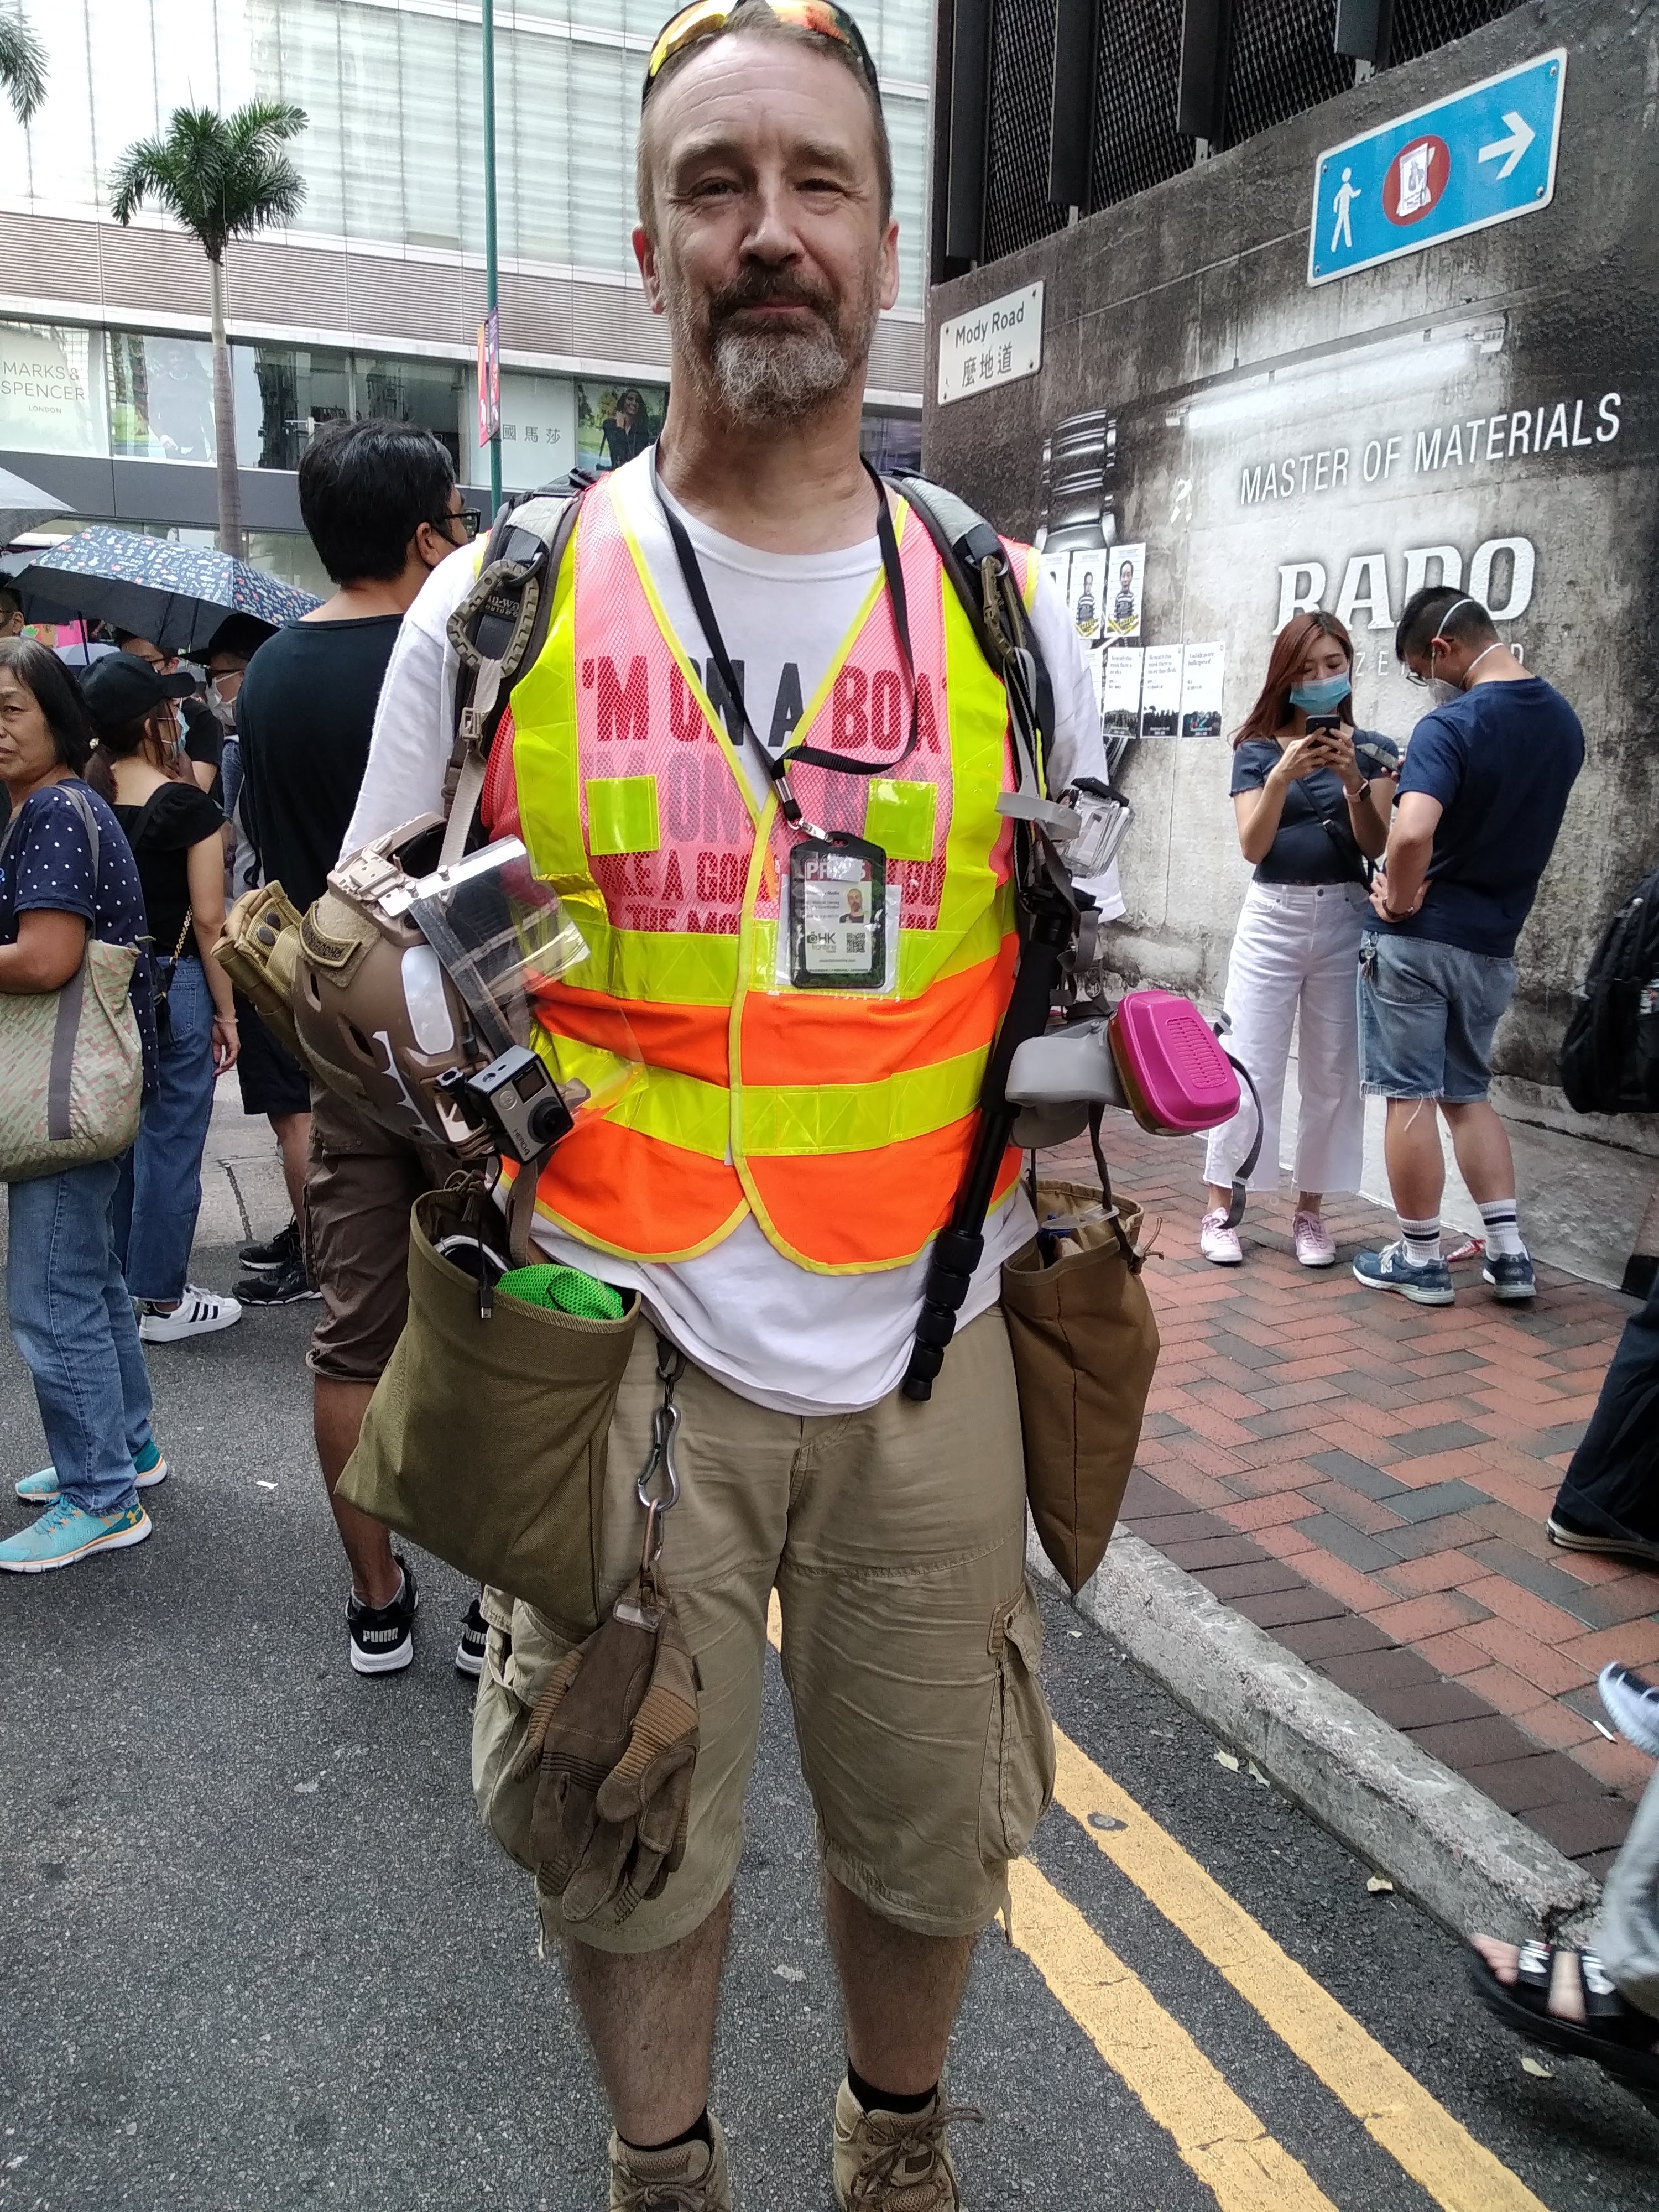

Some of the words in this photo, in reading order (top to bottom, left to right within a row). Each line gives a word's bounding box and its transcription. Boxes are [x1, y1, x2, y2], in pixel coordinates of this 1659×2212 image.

[956, 319, 988, 348] Mody
[992, 300, 1024, 333] Road
[3, 361, 65, 380] MARKS
[70, 368, 80, 380] &
[1, 380, 85, 400] SPENCER
[503, 424, 561, 444] 國馬莎
[1240, 447, 1349, 505] MASTER
[1363, 435, 1402, 482] OF
[1414, 392, 1621, 473] MATERIALS
[1272, 536, 1535, 636] RADO
[768, 662, 807, 747] A
[831, 665, 947, 755] BOA
[818, 933, 836, 944] HK
[513, 1128, 531, 1155] HERO4
[363, 1627, 399, 1643] PUMA
